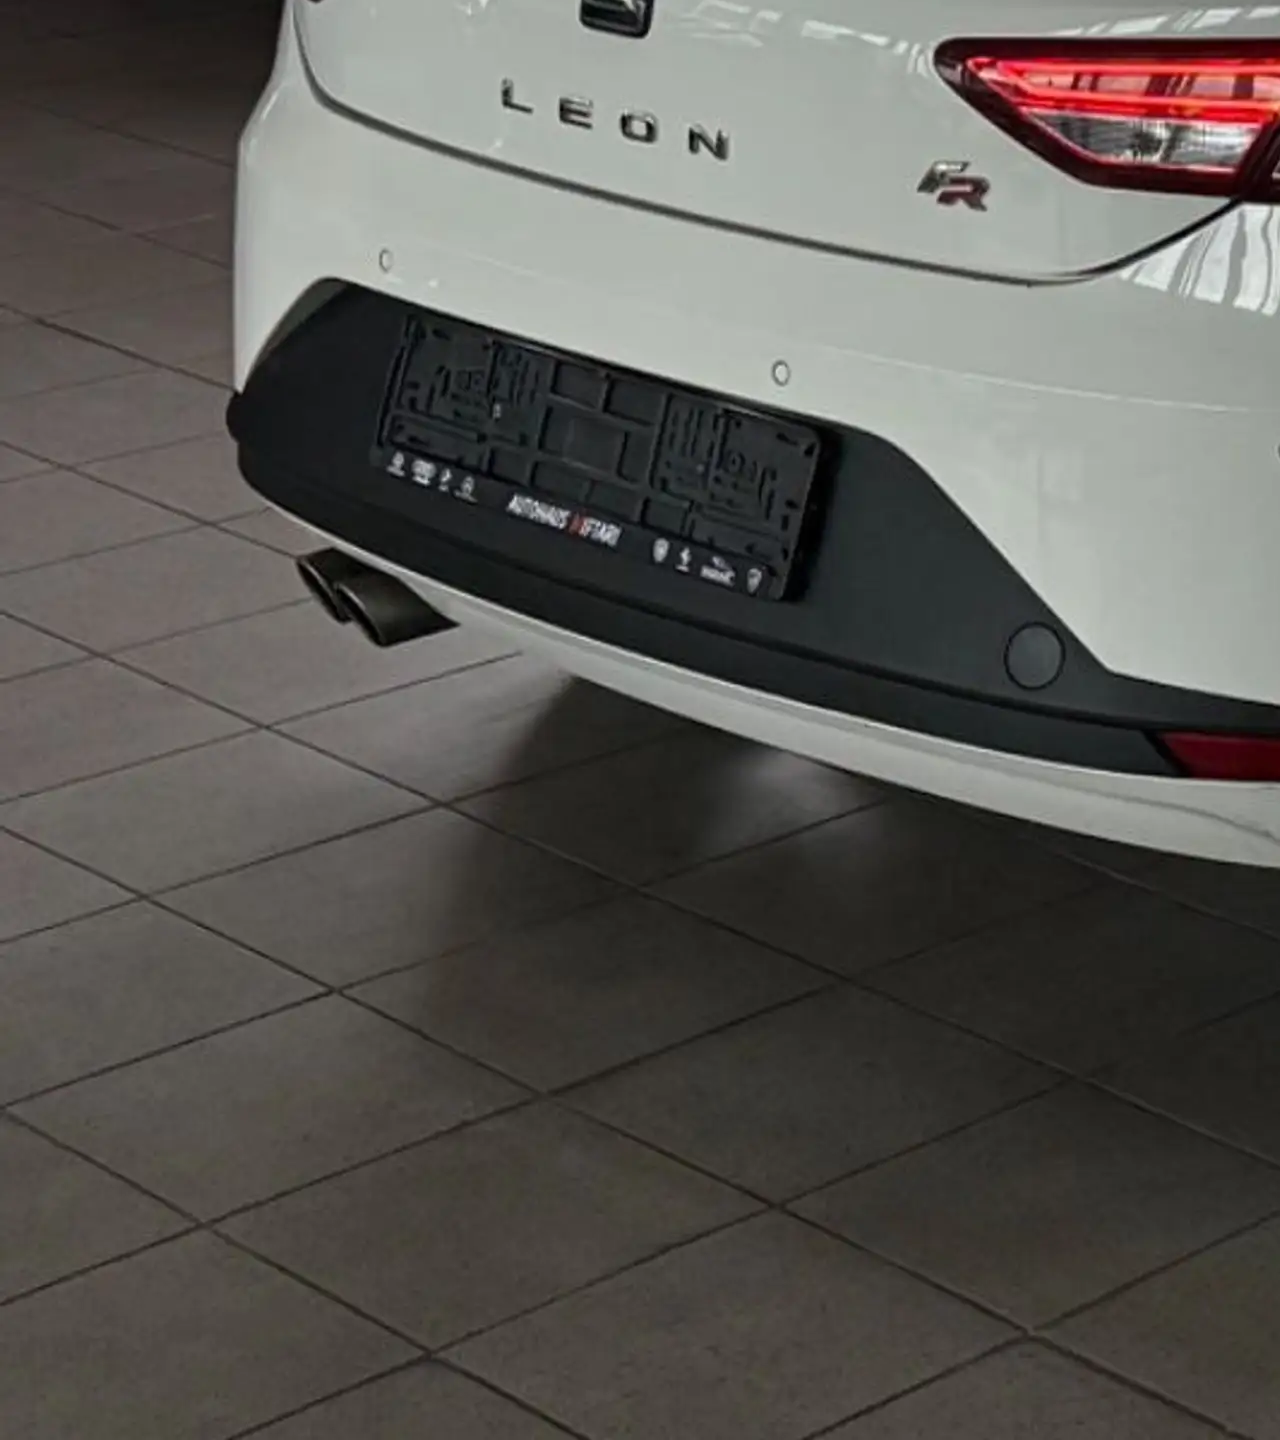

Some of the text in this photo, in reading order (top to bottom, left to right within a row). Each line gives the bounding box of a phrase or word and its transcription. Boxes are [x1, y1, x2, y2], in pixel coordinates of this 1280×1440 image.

[500, 78, 730, 161] LEON
[916, 160, 991, 212] FR
[505, 492, 570, 531] AUTOHAUS
